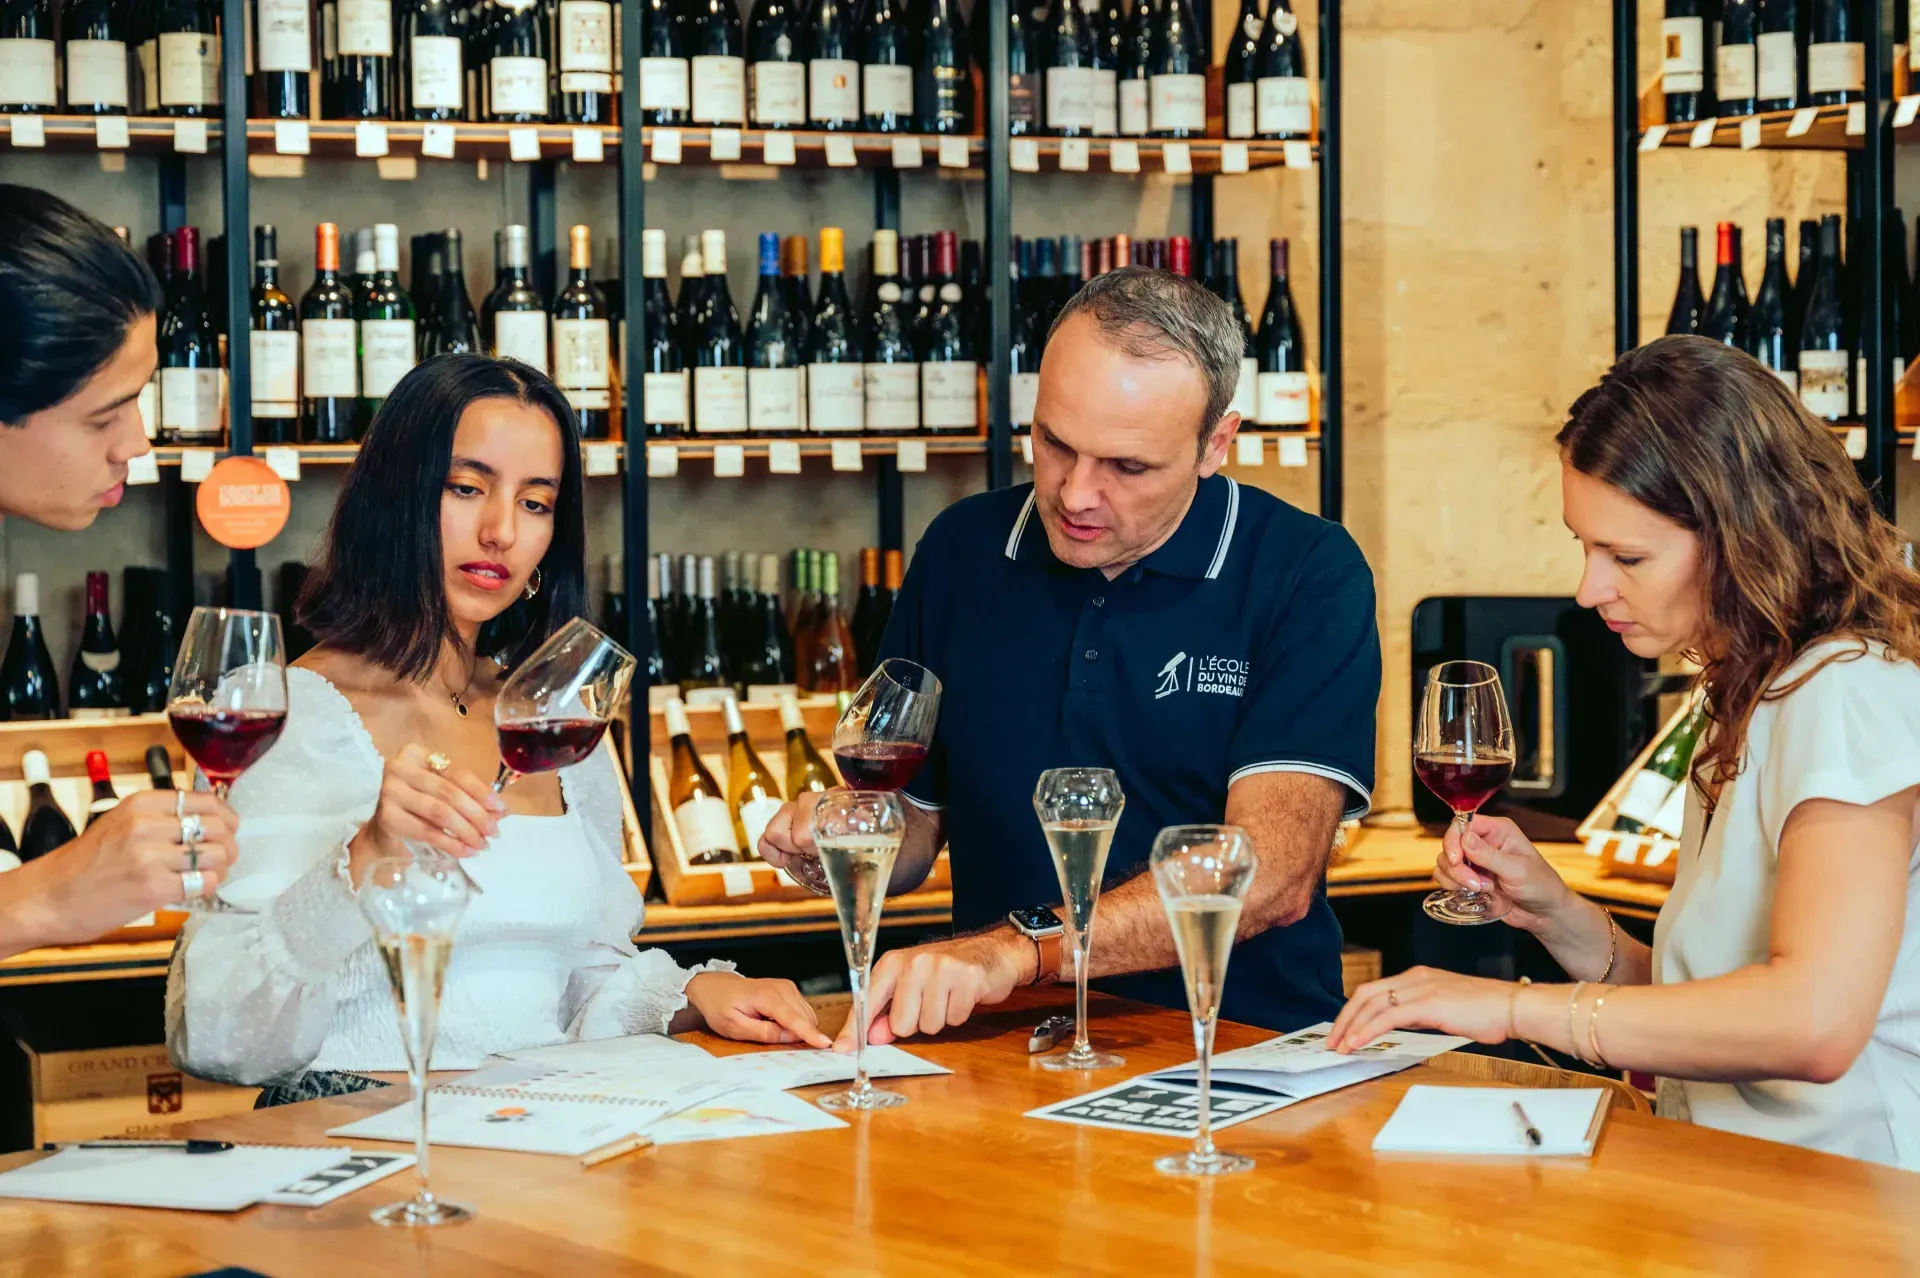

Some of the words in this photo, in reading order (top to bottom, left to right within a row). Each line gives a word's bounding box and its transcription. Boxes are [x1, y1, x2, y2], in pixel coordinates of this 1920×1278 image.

[1199, 655, 1250, 674] L'ÉCOLE
[1198, 672, 1215, 682] DU
[1217, 672, 1237, 684] VIN
[1238, 675, 1247, 686] DE
[1197, 683, 1244, 697] BORDEAU
[142, 1053, 169, 1068] CR
[1171, 1094, 1265, 1112] LE
